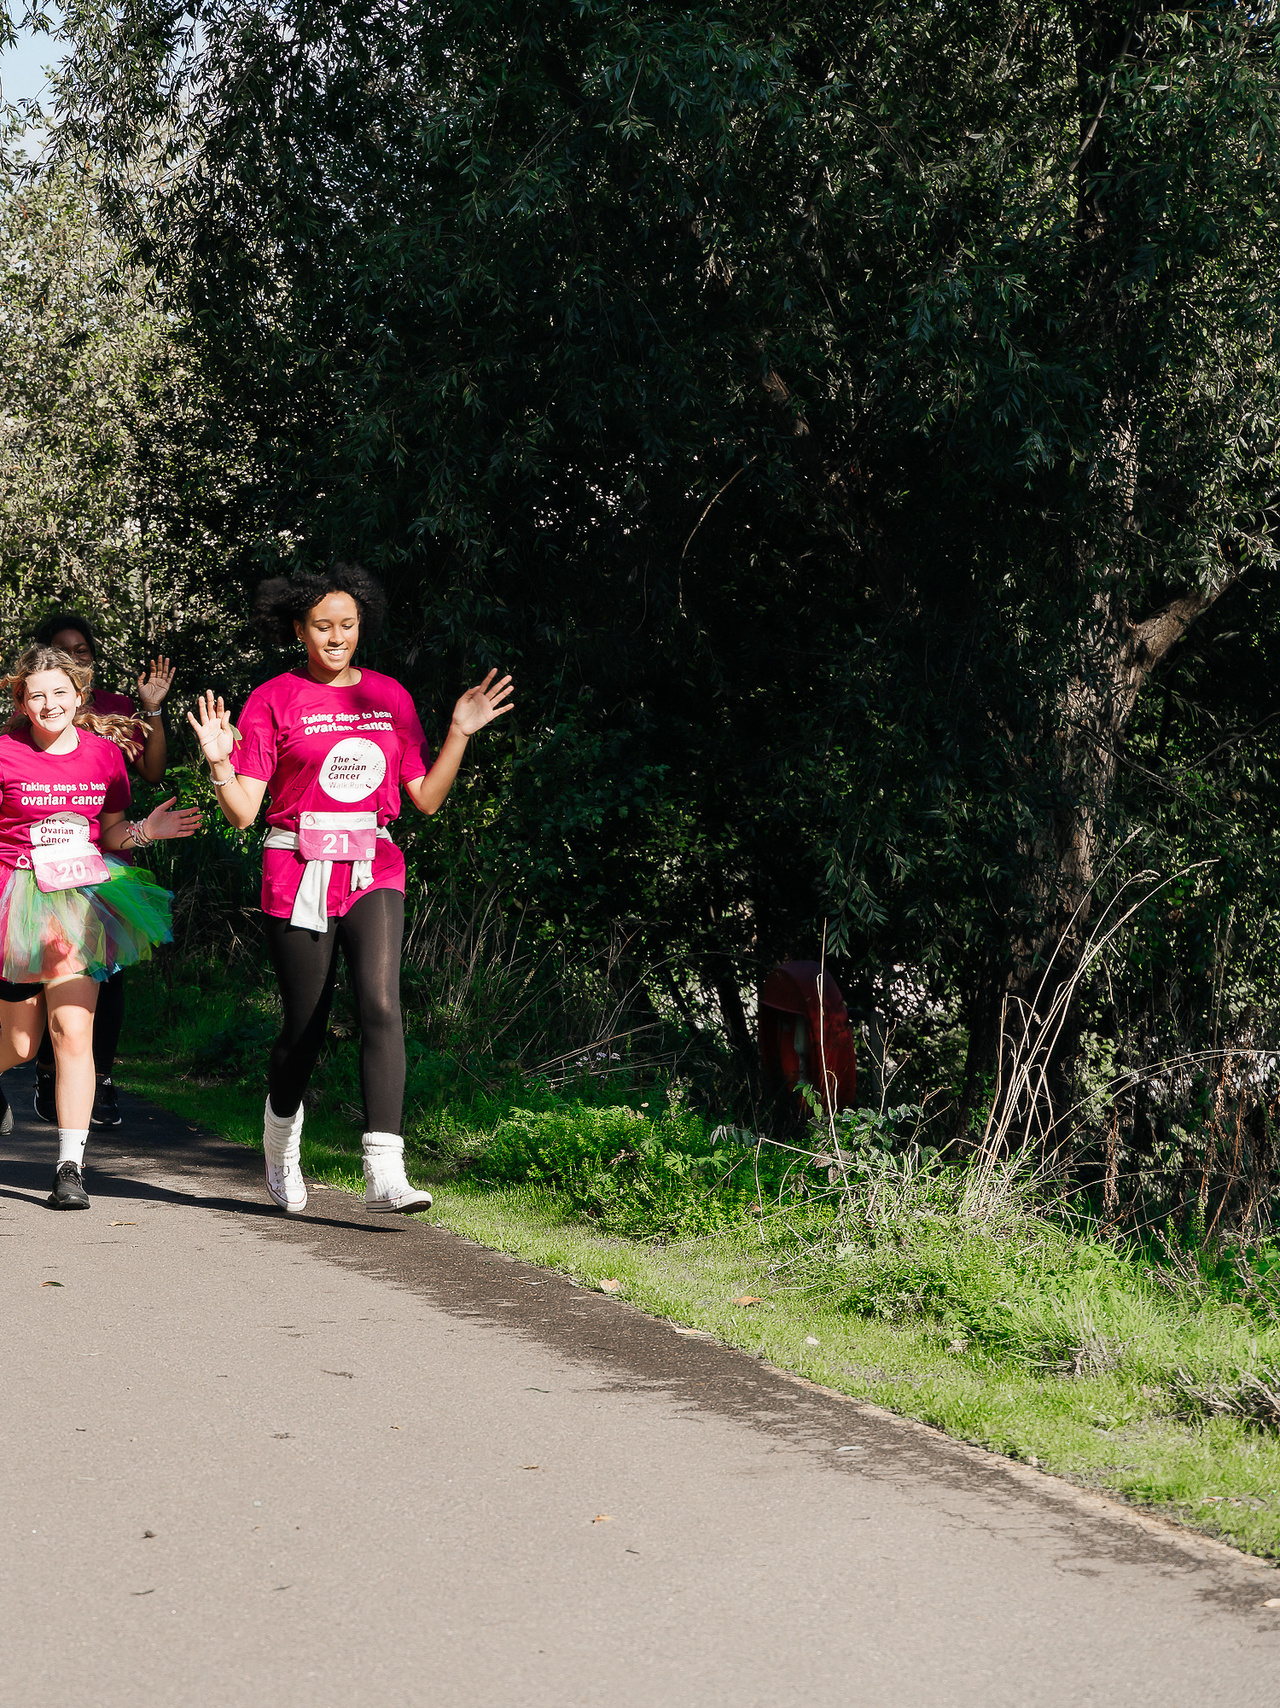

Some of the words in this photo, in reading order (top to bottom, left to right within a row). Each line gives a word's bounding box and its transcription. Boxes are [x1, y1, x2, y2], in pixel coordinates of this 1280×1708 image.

[301, 713, 334, 724] Taking
[335, 713, 360, 723] steps
[328, 772, 361, 780] Cancer
[21, 782, 50, 793] Taking
[53, 783, 77, 793] steps
[79, 783, 89, 791] to
[90, 782, 106, 791] beat
[21, 794, 67, 805] ovarian
[40, 827, 74, 835] Ovarian
[40, 836, 70, 844] Cancer
[322, 834, 350, 854] 21
[58, 861, 87, 884] 20
